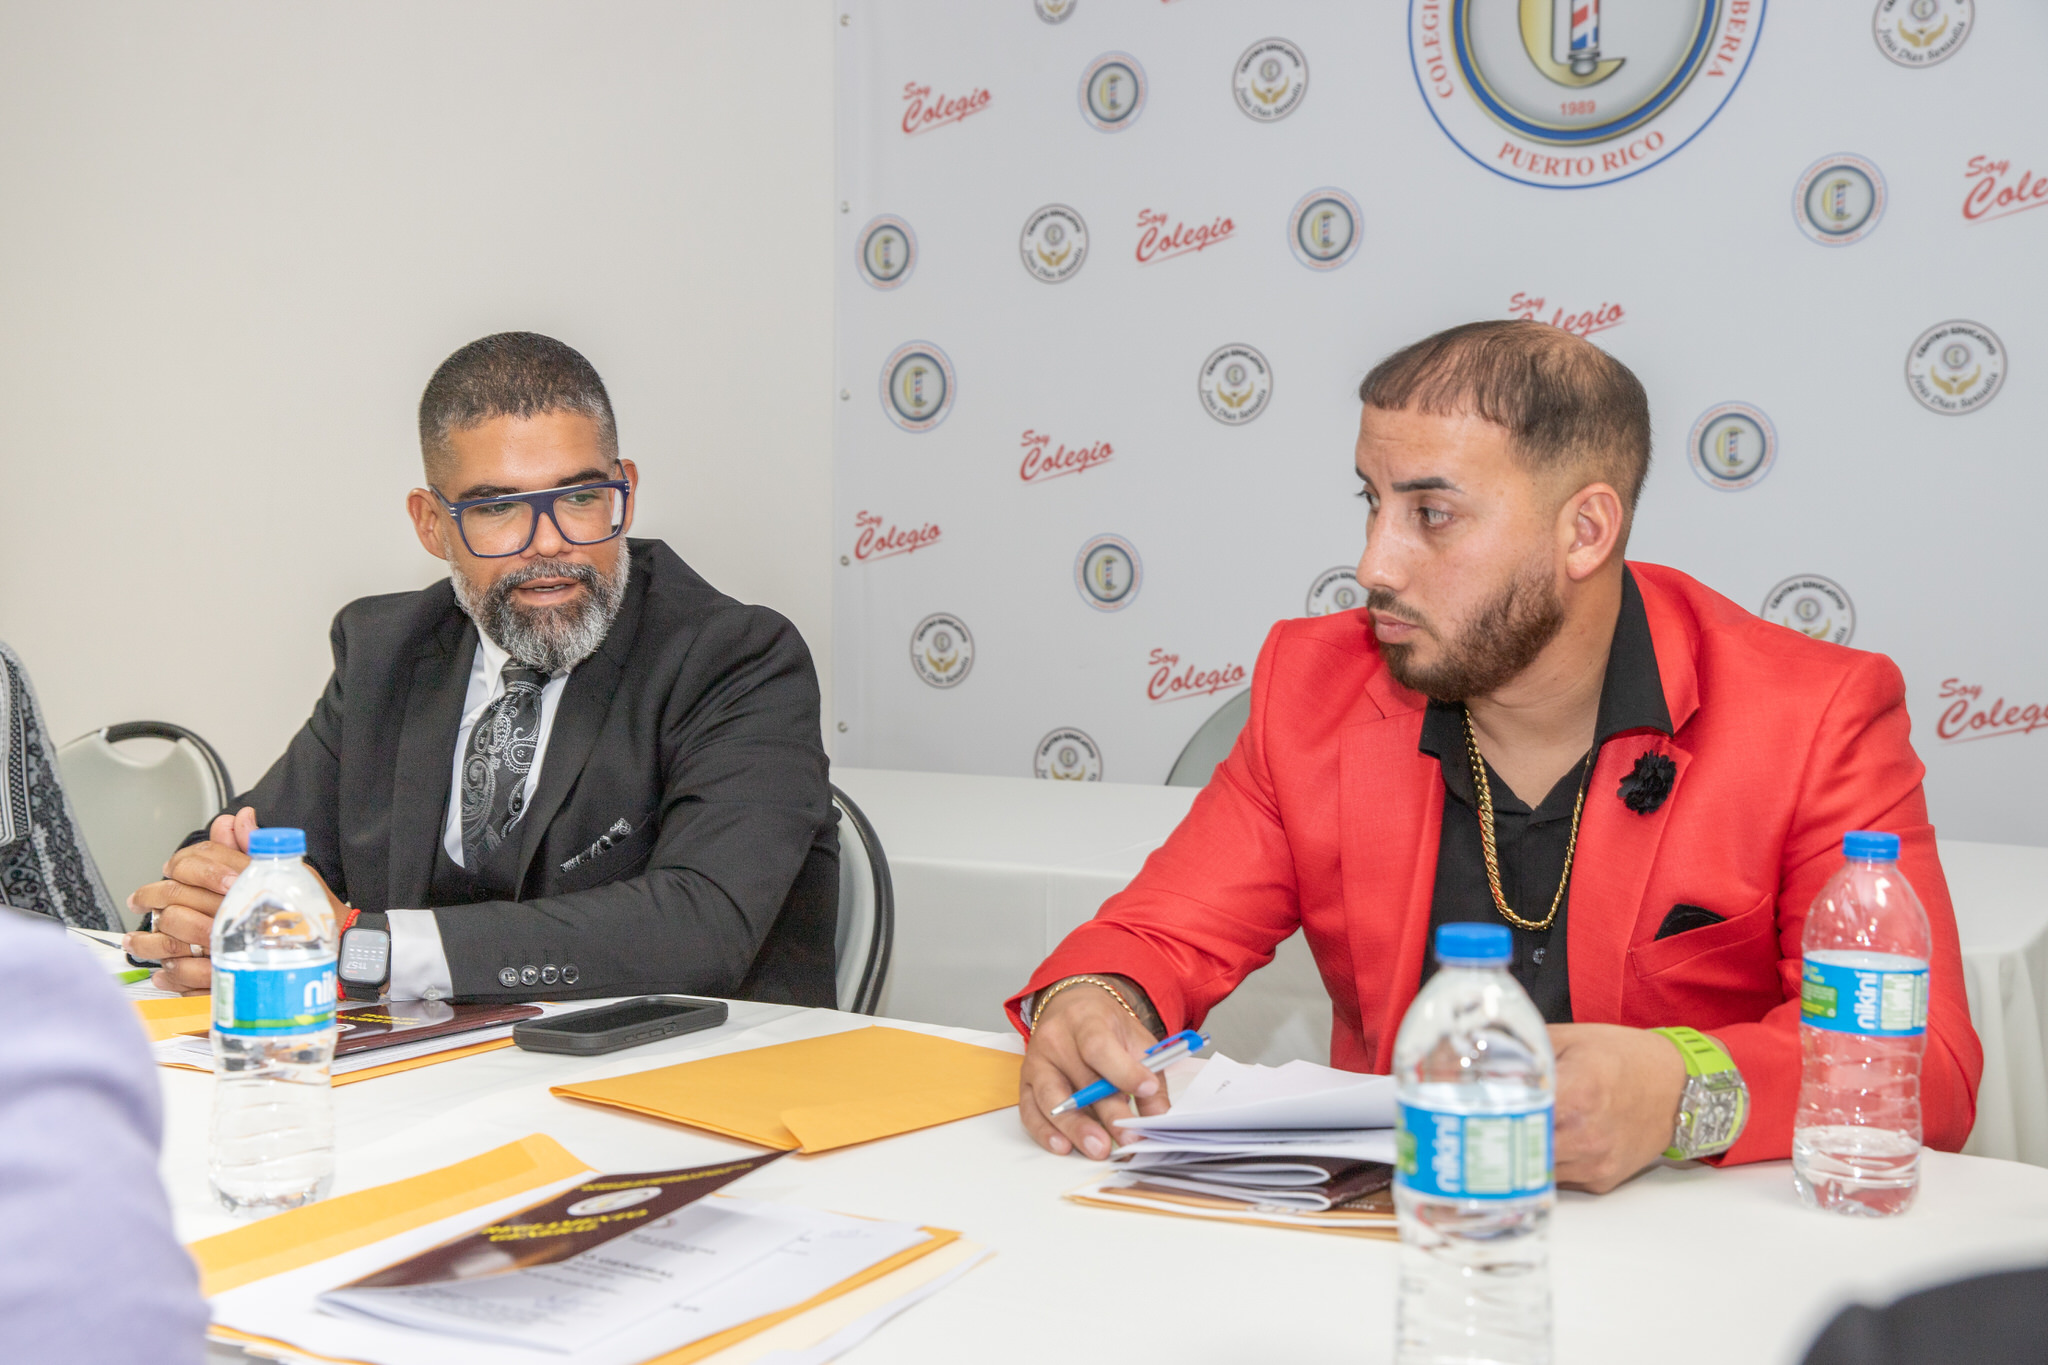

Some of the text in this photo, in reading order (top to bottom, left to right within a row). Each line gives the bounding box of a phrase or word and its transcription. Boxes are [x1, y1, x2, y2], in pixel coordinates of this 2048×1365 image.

[1422, 0, 1455, 99] COLEGI
[903, 81, 931, 100] Soy
[902, 87, 992, 134] Colegio
[1560, 100, 1597, 117] 1989
[1497, 131, 1665, 178] PUERTO RICO
[1964, 155, 2010, 178] Soy
[1137, 208, 1168, 228] Soy
[1136, 215, 1235, 263] Colegio
[1509, 292, 1545, 312] Soy
[1021, 429, 1050, 448] Soy
[1020, 440, 1113, 482] Colegio
[856, 510, 882, 528] Soy
[854, 521, 941, 560] Colegio
[1148, 647, 1179, 667] Soy
[1147, 661, 1246, 700] Colegio
[1938, 678, 1983, 701] Soy
